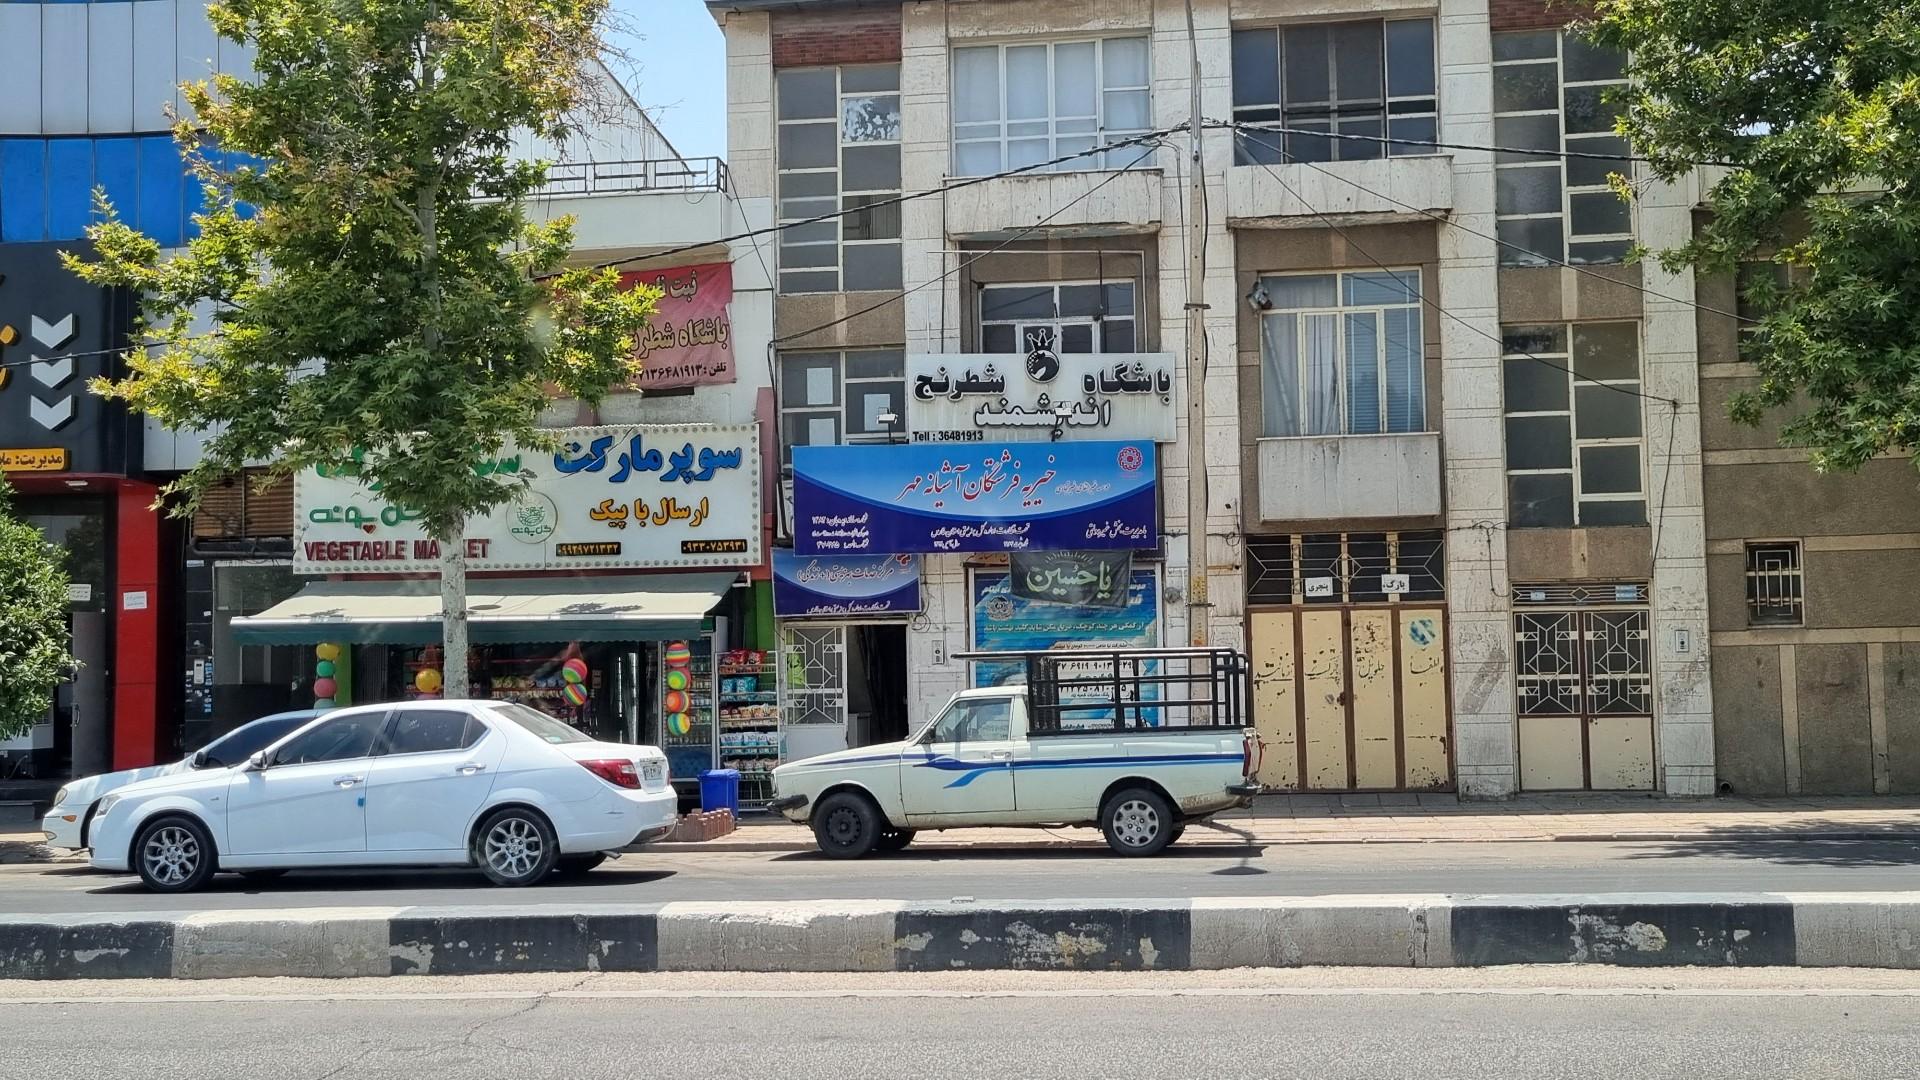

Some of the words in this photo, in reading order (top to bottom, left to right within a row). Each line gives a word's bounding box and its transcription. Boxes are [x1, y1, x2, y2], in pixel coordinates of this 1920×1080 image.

[669, 269, 698, 303] ثبت
[678, 316, 730, 350] باشگاه
[912, 361, 1007, 402] شطرنج
[1081, 360, 1172, 404] باشگاه
[938, 431, 984, 442] 36481913
[590, 499, 629, 530] پیک
[633, 499, 650, 529] با
[651, 496, 711, 528] ارسال
[304, 540, 406, 563] VEGETABLE
[413, 538, 492, 561] MAET
